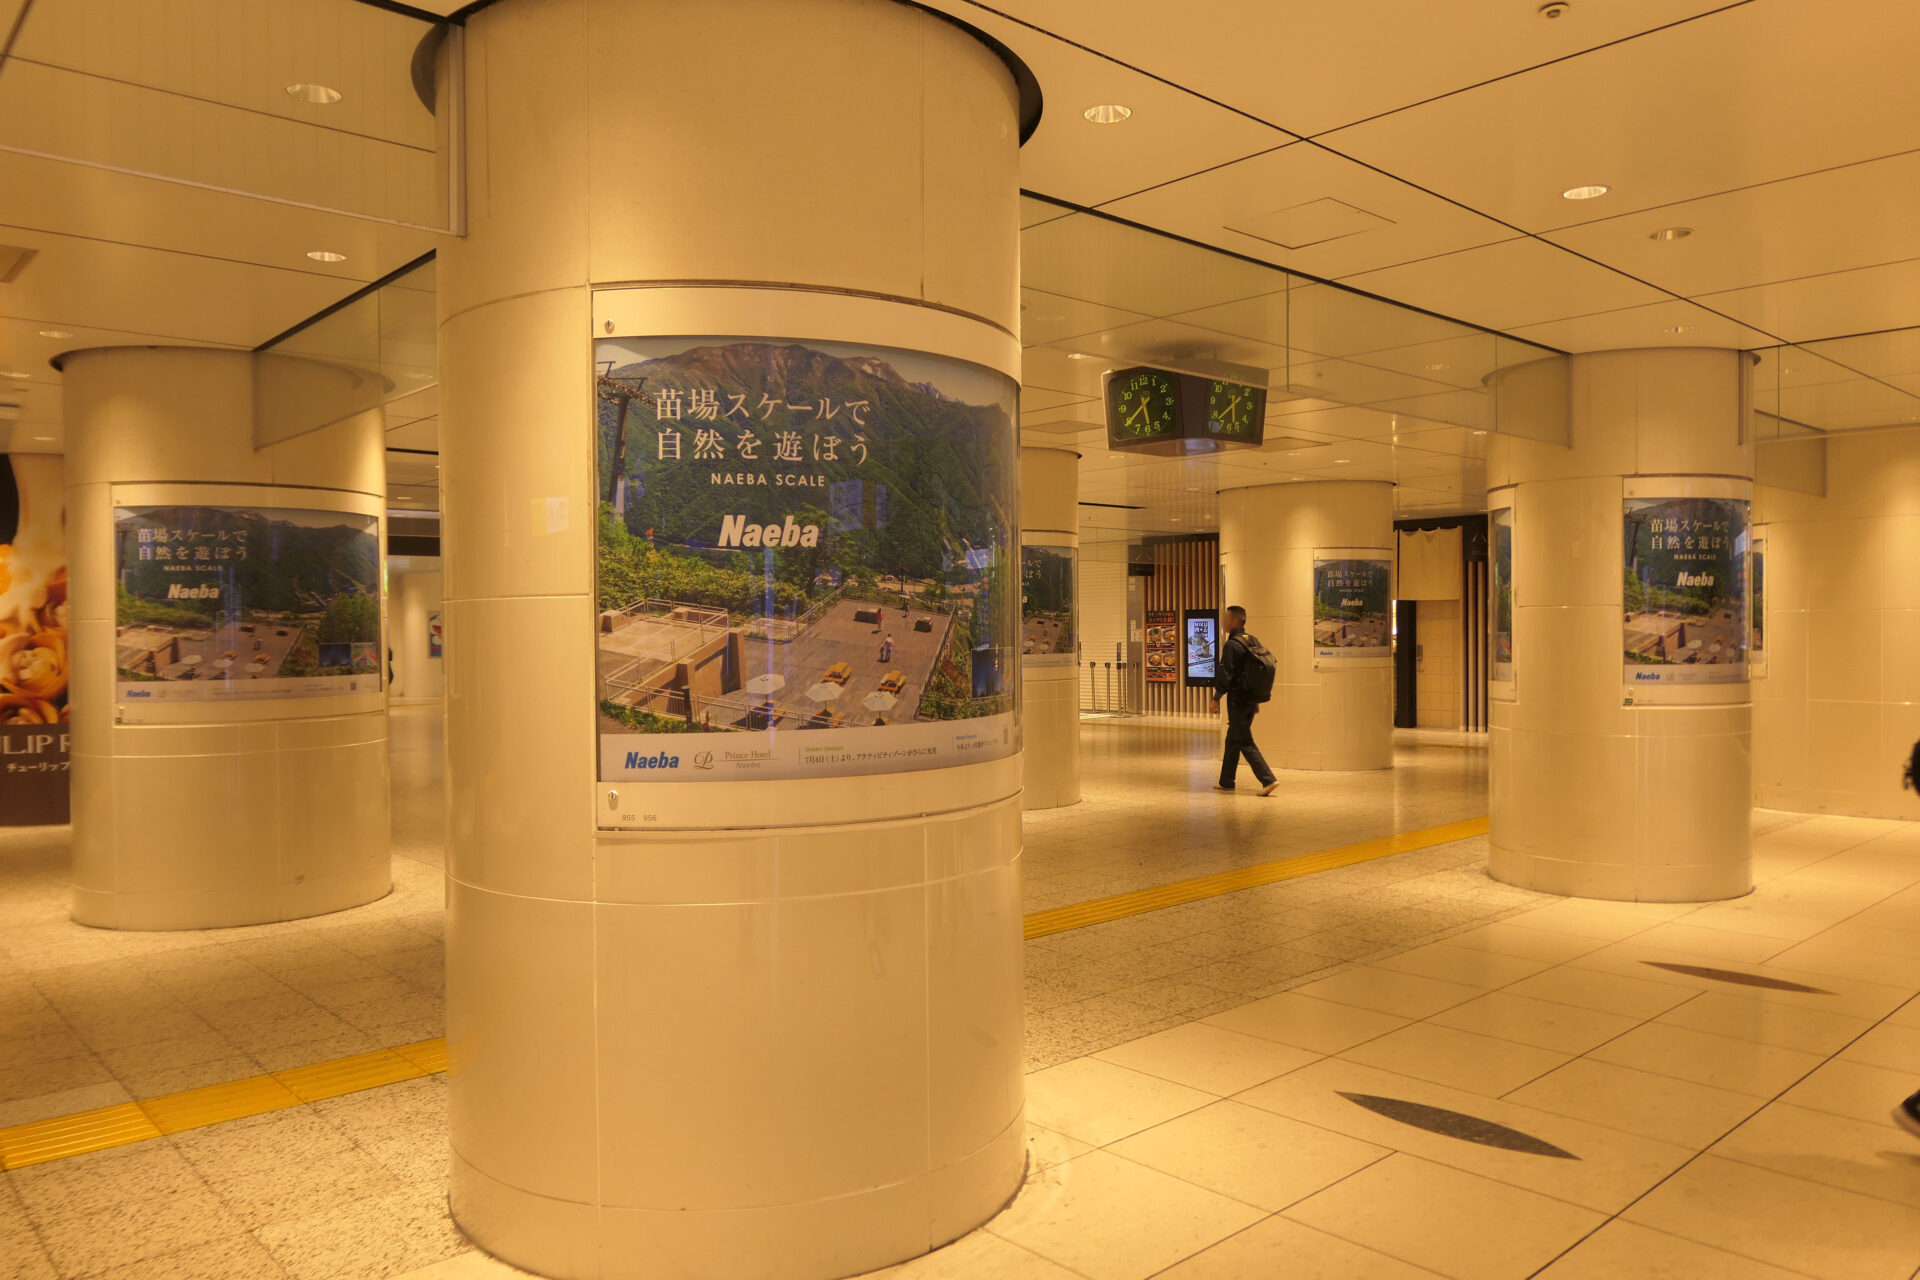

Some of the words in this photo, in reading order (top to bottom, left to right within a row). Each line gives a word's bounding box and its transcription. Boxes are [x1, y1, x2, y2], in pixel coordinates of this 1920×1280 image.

[1139, 377, 1148, 385] 12
[1131, 382, 1138, 390] 11
[1124, 392, 1132, 400] 10
[1211, 396, 1215, 404] 9
[1166, 397, 1171, 405] 3
[653, 388, 871, 425] 苗場スケールで
[1154, 421, 1160, 429] 5
[658, 427, 868, 466] 自然を遊ぼう
[711, 473, 767, 485] NAEBA
[776, 474, 825, 487] SCALE
[718, 514, 819, 547] Naeba
[1676, 571, 1714, 586] Naeba
[167, 584, 220, 599] Naeba
[1635, 672, 1660, 680] Naeba
[725, 751, 750, 759] Prince
[751, 750, 771, 758] Hotel
[624, 751, 680, 769] Naeba
